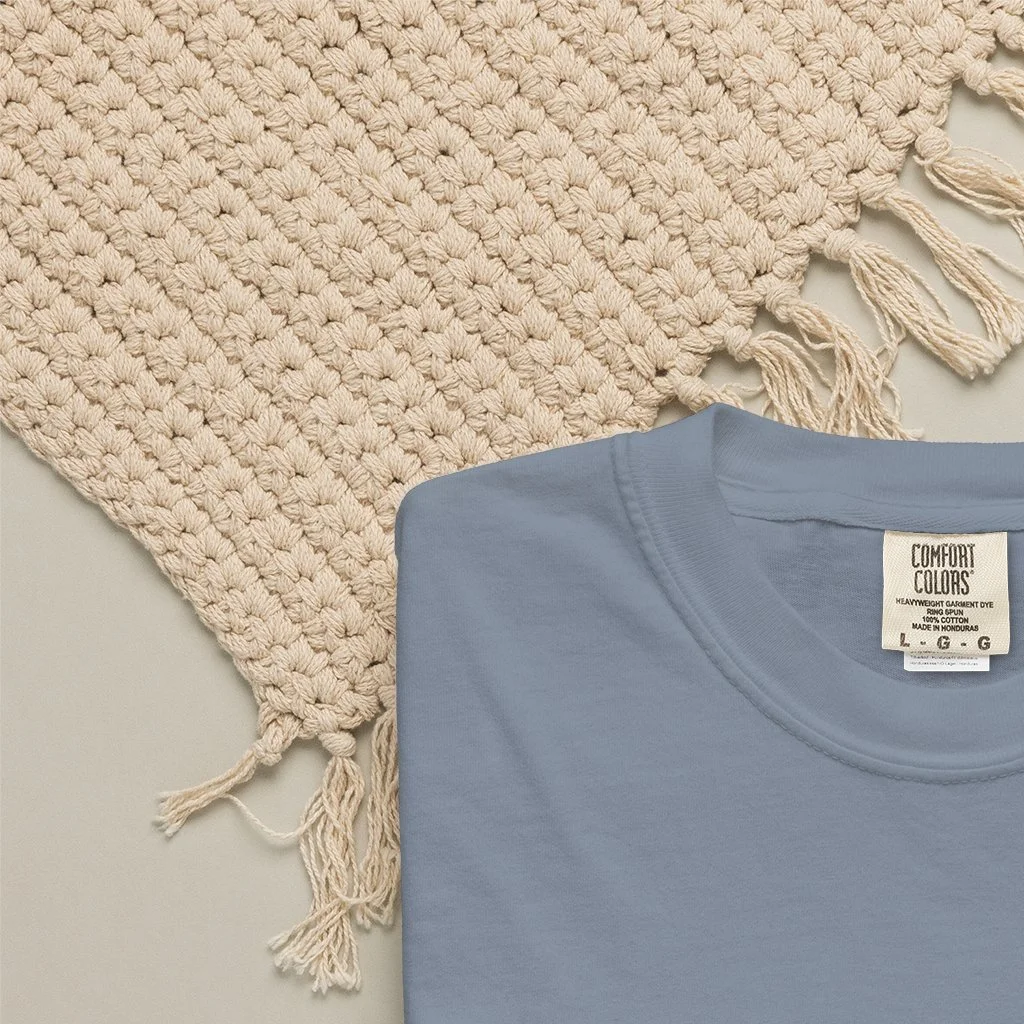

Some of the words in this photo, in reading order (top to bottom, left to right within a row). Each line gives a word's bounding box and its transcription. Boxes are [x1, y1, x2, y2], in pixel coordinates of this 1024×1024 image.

[911, 543, 975, 568] COMFORT
[895, 597, 945, 608] HEAVYWEIGHT
[945, 600, 979, 608] GARMENT
[980, 601, 994, 609] DYE
[944, 608, 964, 616] SPUN
[911, 623, 932, 631] MADE
[932, 624, 940, 632] IN
[941, 624, 979, 632] HONDURAS
[899, 632, 911, 648] L
[936, 635, 951, 650] G
[977, 635, 991, 651] G
